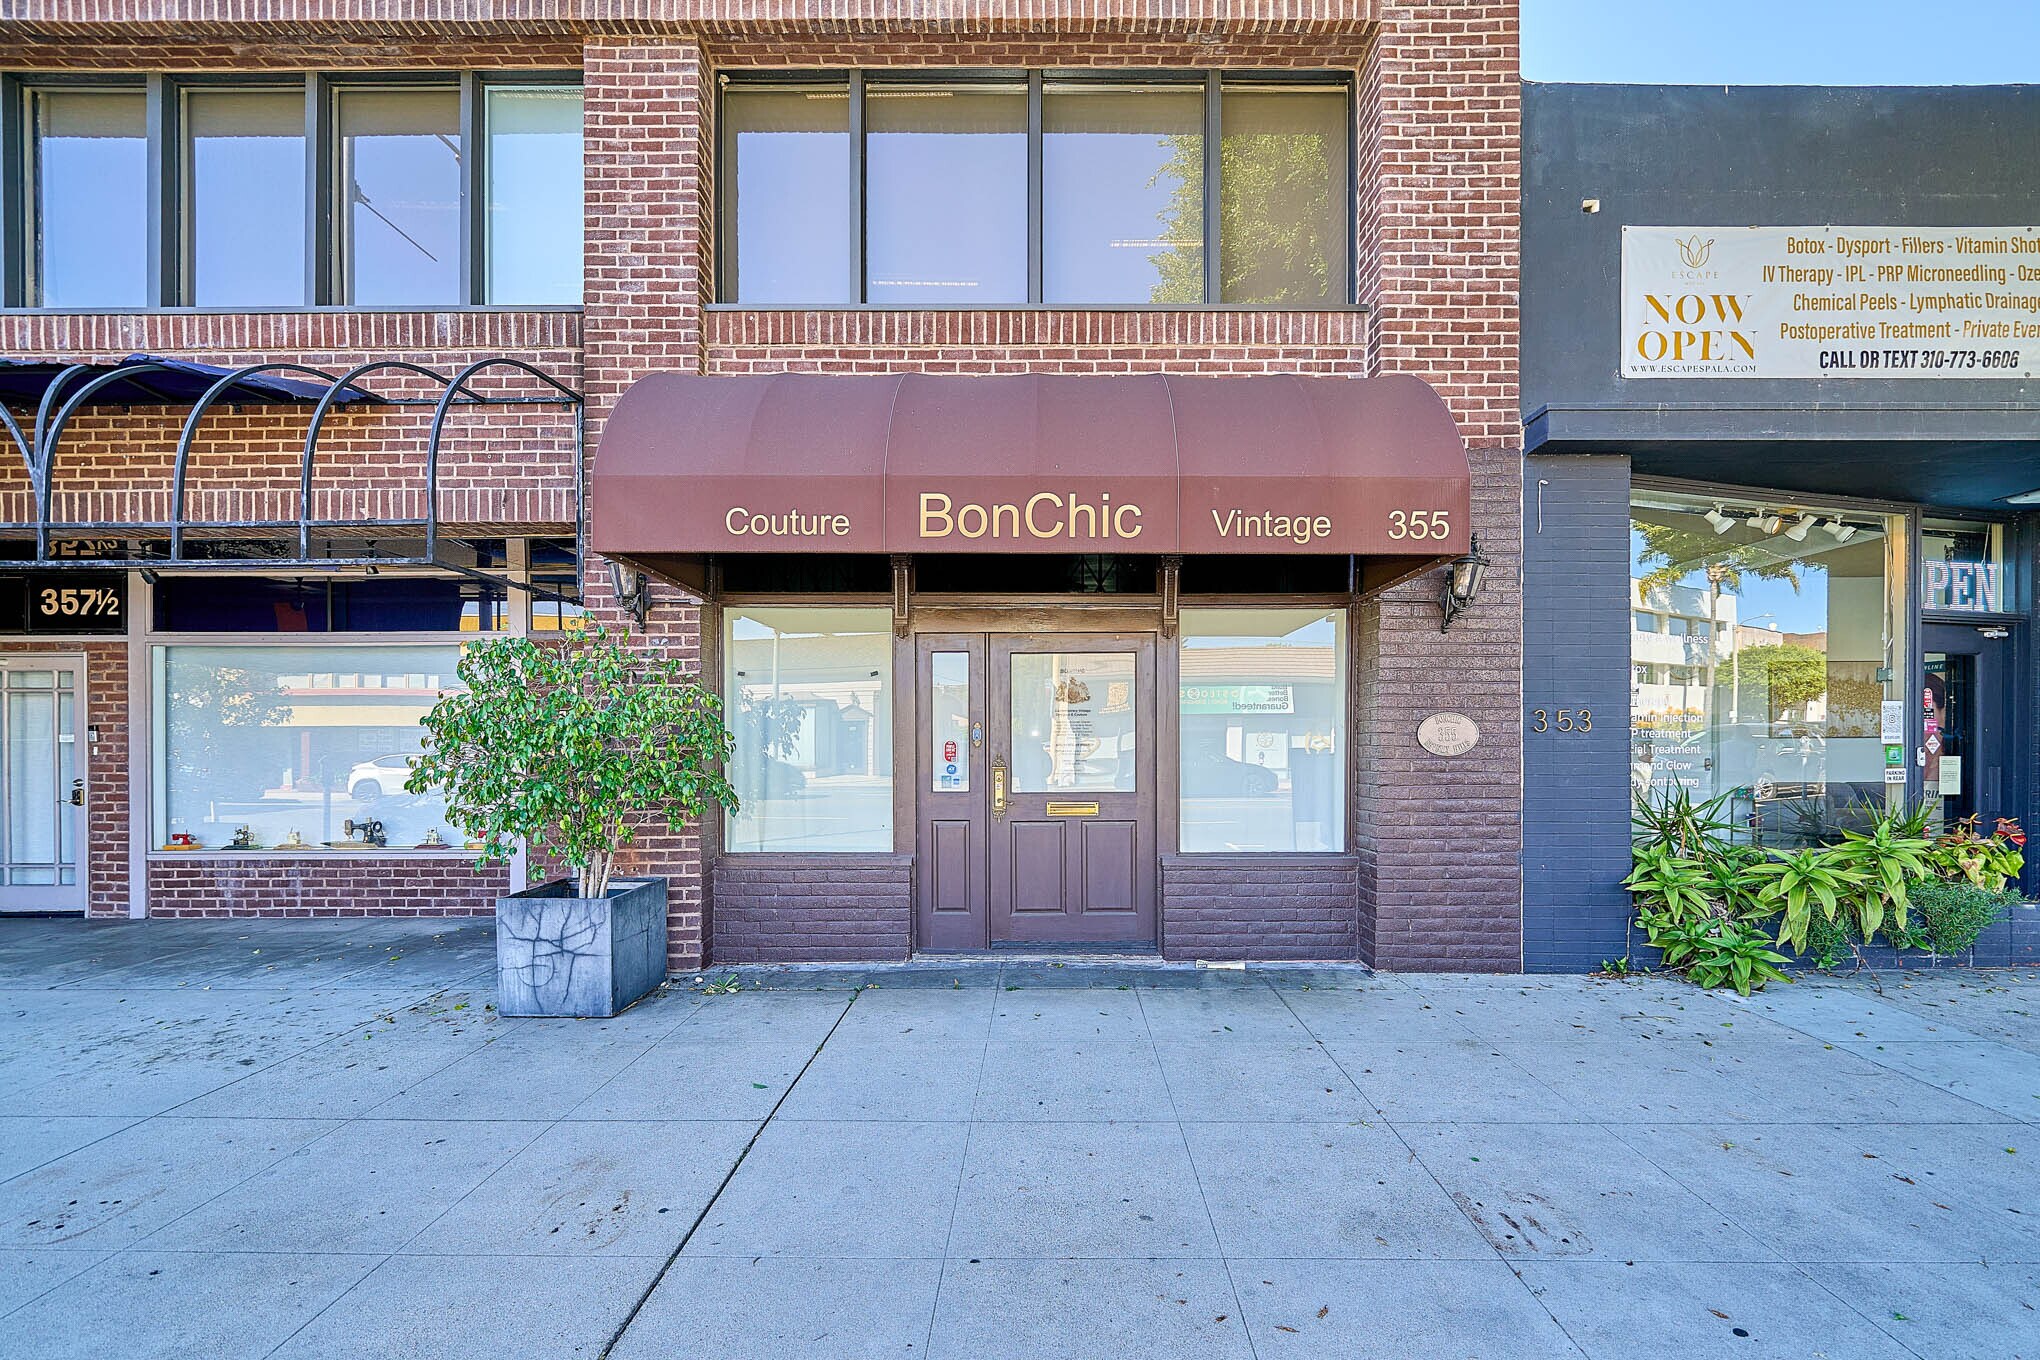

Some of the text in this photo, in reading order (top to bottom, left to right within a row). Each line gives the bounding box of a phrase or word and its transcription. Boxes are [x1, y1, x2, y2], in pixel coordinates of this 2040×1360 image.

[1787, 237, 1825, 254] Botox
[1836, 237, 1890, 258] Dysport
[1902, 237, 1944, 254] Fillers
[1955, 236, 2008, 254] Vitamin
[1671, 271, 1719, 279] ESCAPE
[1763, 265, 1775, 282] IV
[1778, 265, 1834, 286] Therapy
[1846, 265, 1866, 282] IPL
[1877, 265, 1903, 282] PRP
[1907, 264, 2006, 285] Microneedling
[1643, 294, 1752, 325] NOW
[1793, 293, 1856, 311] Chemical
[1860, 293, 1897, 310] Peels
[1910, 292, 1982, 313] Lymphatic
[1780, 321, 1876, 343] Postoperative
[1879, 321, 1951, 338] Treatment
[1963, 319, 2010, 338] Private
[1637, 330, 1759, 361] OPEN
[1631, 365, 1756, 373] WWW.ESCAPESPALA.COM
[1820, 350, 2020, 369] CALL OR TEXT 310-773-6606
[725, 492, 1450, 544] Couture BonChic Vintage 355
[1921, 560, 1998, 613] PEN
[1533, 709, 1592, 732] 353
[1437, 727, 1457, 741] 355
[1641, 729, 1691, 738] treatment
[1649, 744, 1701, 753] Treatment
[1666, 759, 1692, 770] Glow
